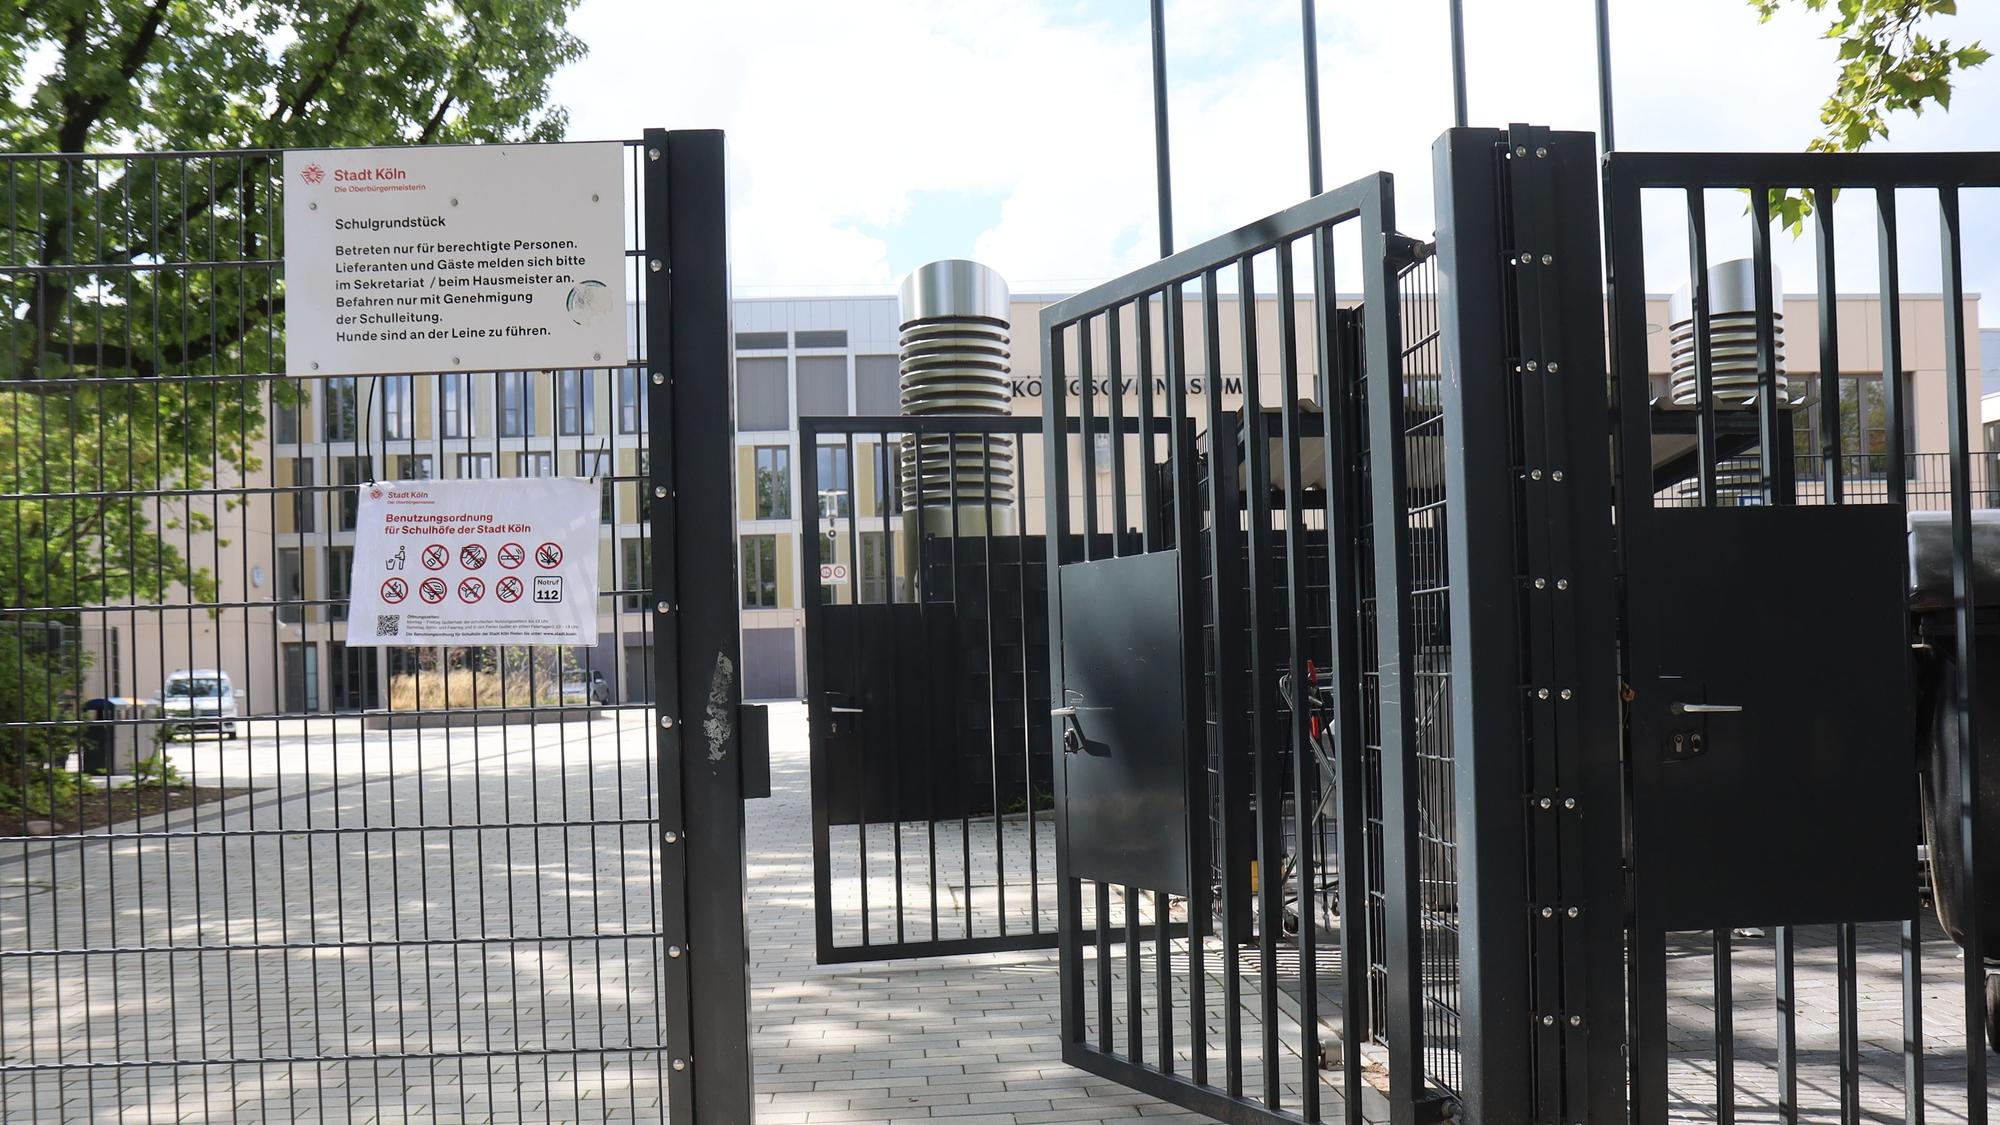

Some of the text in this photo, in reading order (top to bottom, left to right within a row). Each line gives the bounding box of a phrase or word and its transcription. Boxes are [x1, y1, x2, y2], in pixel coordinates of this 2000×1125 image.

[334, 168, 406, 181] Stadt Köln
[349, 184, 426, 193] Oberbürgermeisterin
[335, 215, 446, 231] Schulgrundstück
[335, 240, 578, 256] Betreten nur für berechtigte Personen.
[336, 255, 586, 273] Lieferanten und Gäste melden sich bitte
[335, 274, 575, 290] im Sekretariat / beim Hausmeister an.
[336, 292, 533, 307] Befahren nur mit Genehmigung
[336, 312, 443, 325] der Schulleitung.
[336, 326, 551, 342] Hunde sind an der Leine zu führen.
[387, 491, 409, 499] Stadt
[385, 513, 493, 524] Benutzungsordnung
[384, 523, 531, 535] für Schulhöfe der Stadt Köln
[537, 590, 559, 600] 112
